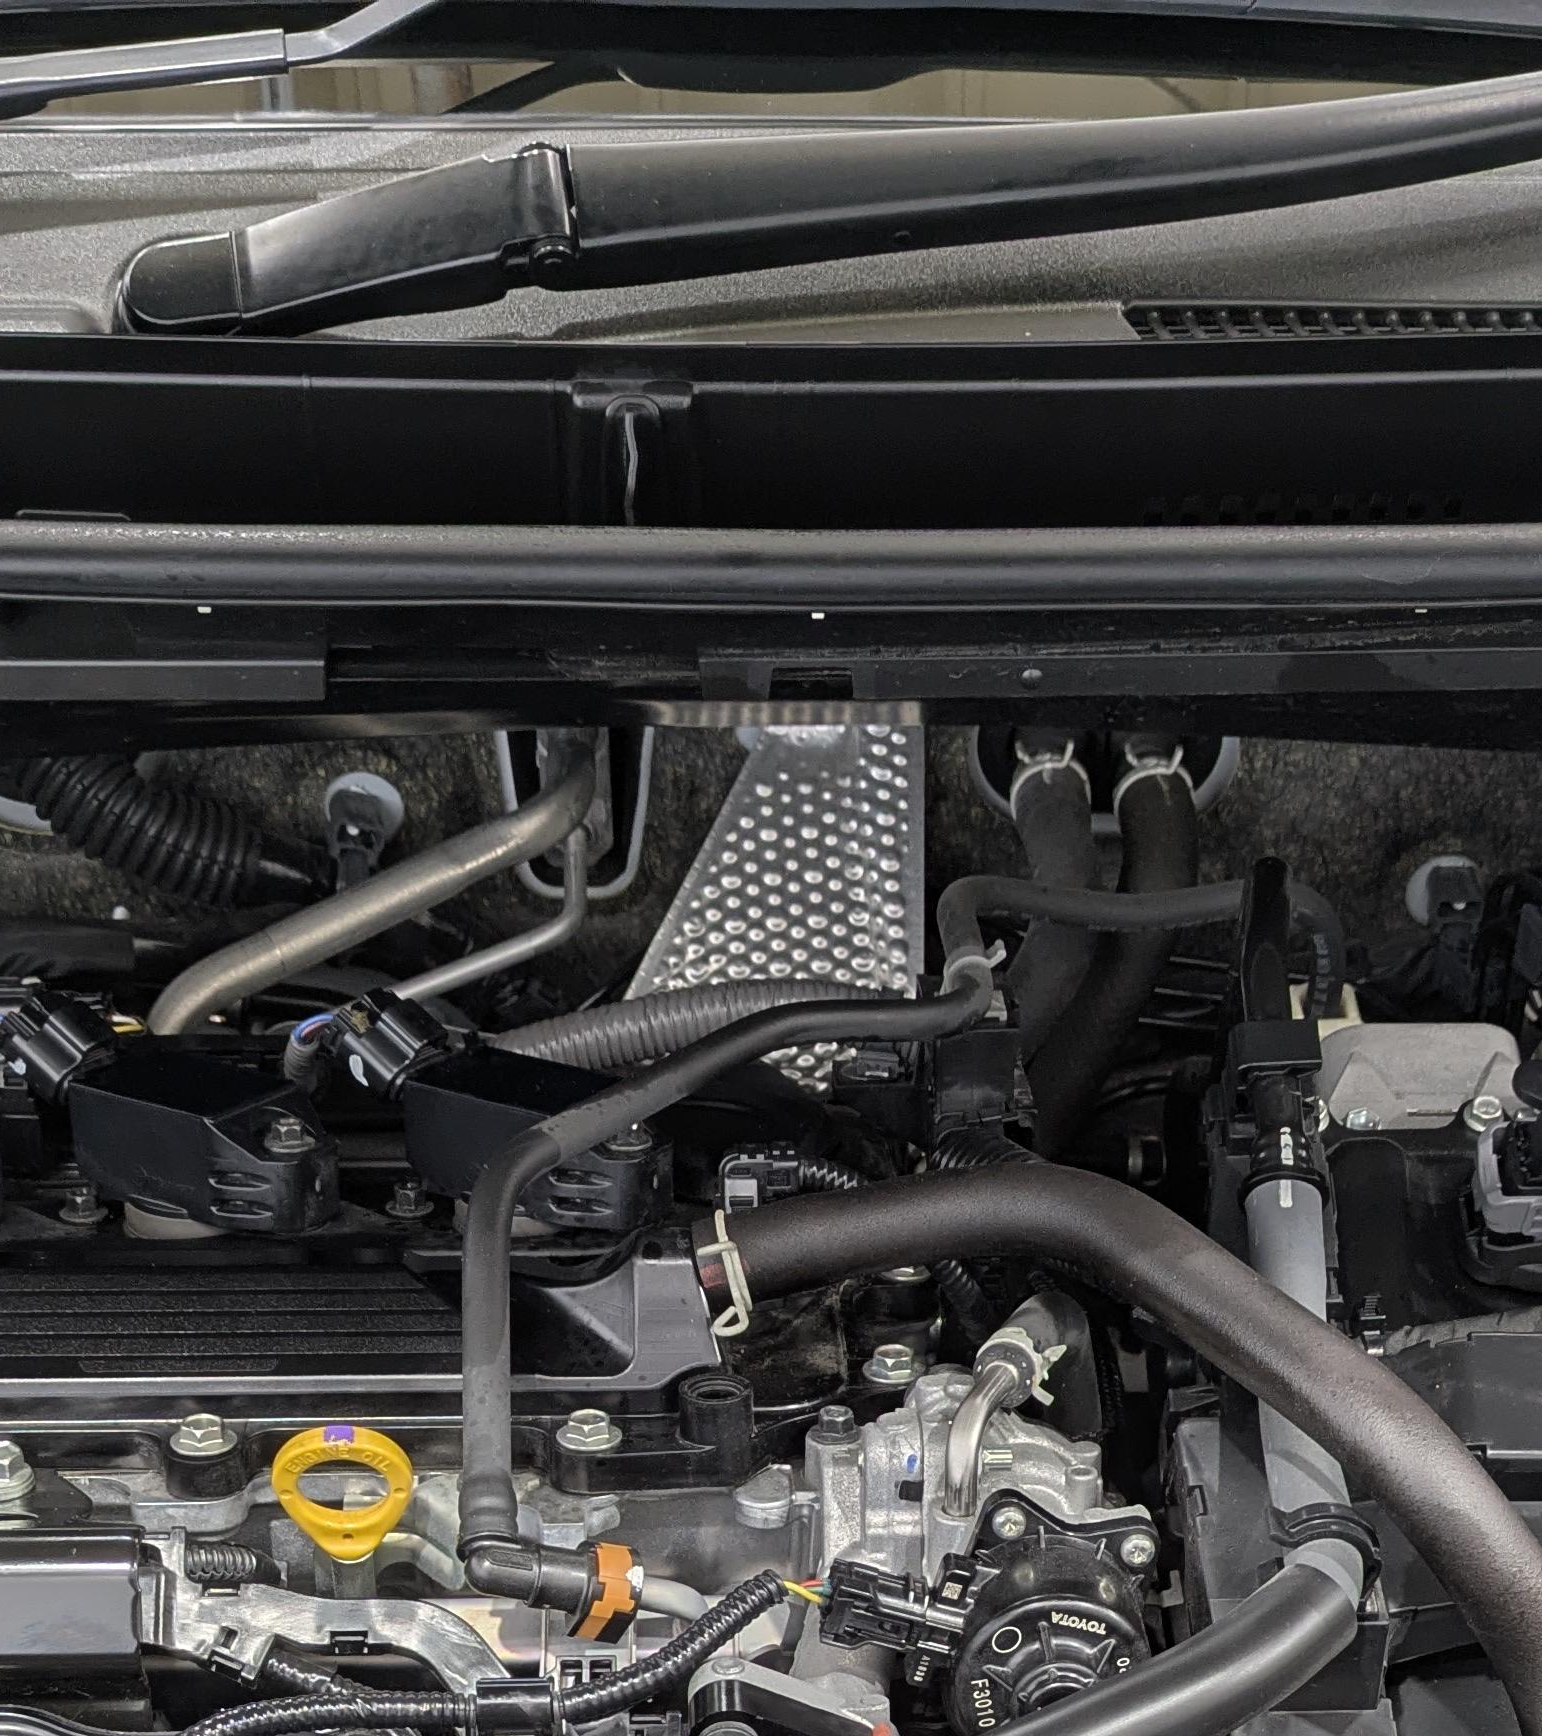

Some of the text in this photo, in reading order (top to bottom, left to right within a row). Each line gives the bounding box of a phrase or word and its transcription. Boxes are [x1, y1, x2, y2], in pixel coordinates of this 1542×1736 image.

[284, 1445, 392, 1474] ENGINE OIL
[1051, 1611, 1107, 1635] TOYOTA
[971, 1678, 996, 1728] F3010
